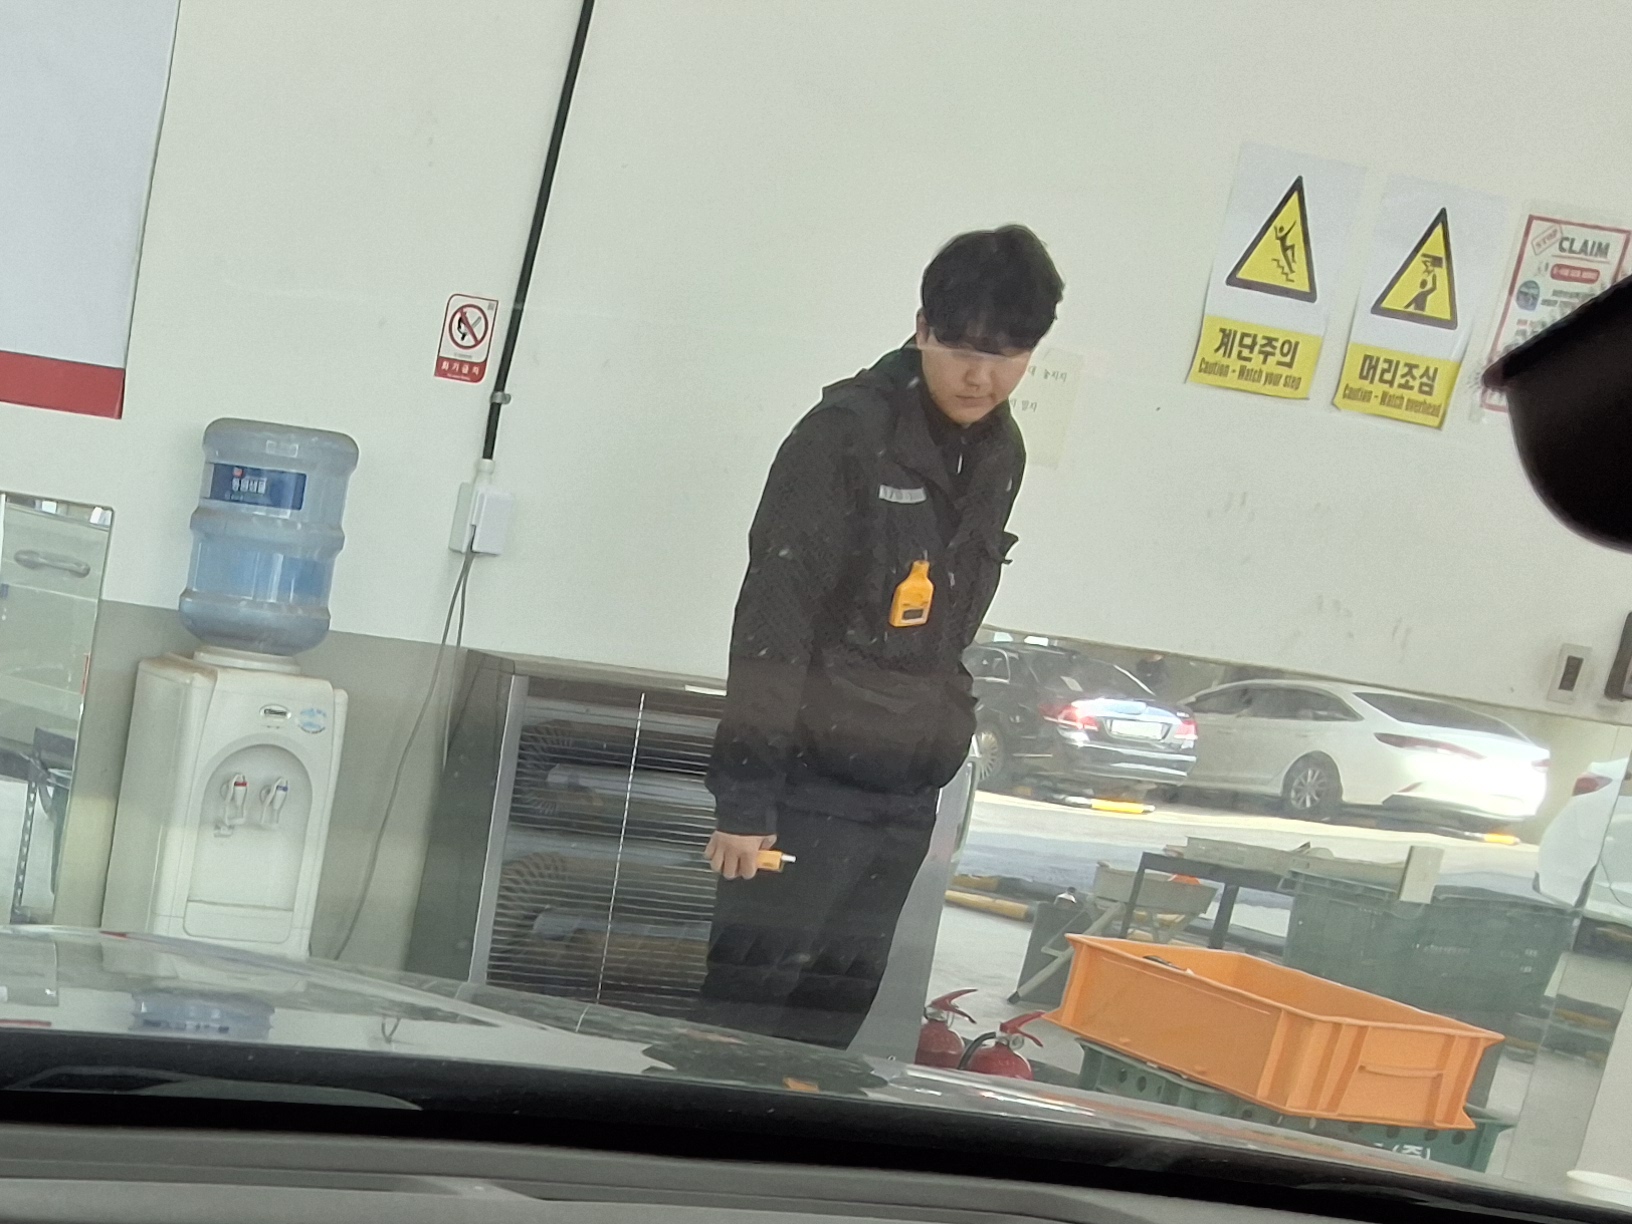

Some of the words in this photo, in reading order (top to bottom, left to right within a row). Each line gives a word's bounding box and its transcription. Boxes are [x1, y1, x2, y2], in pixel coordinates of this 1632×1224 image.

[1558, 236, 1610, 259] CLAIM
[1214, 327, 1300, 369] 계단주의
[1198, 357, 1230, 378] Caution
[1359, 353, 1438, 397] 머리조심
